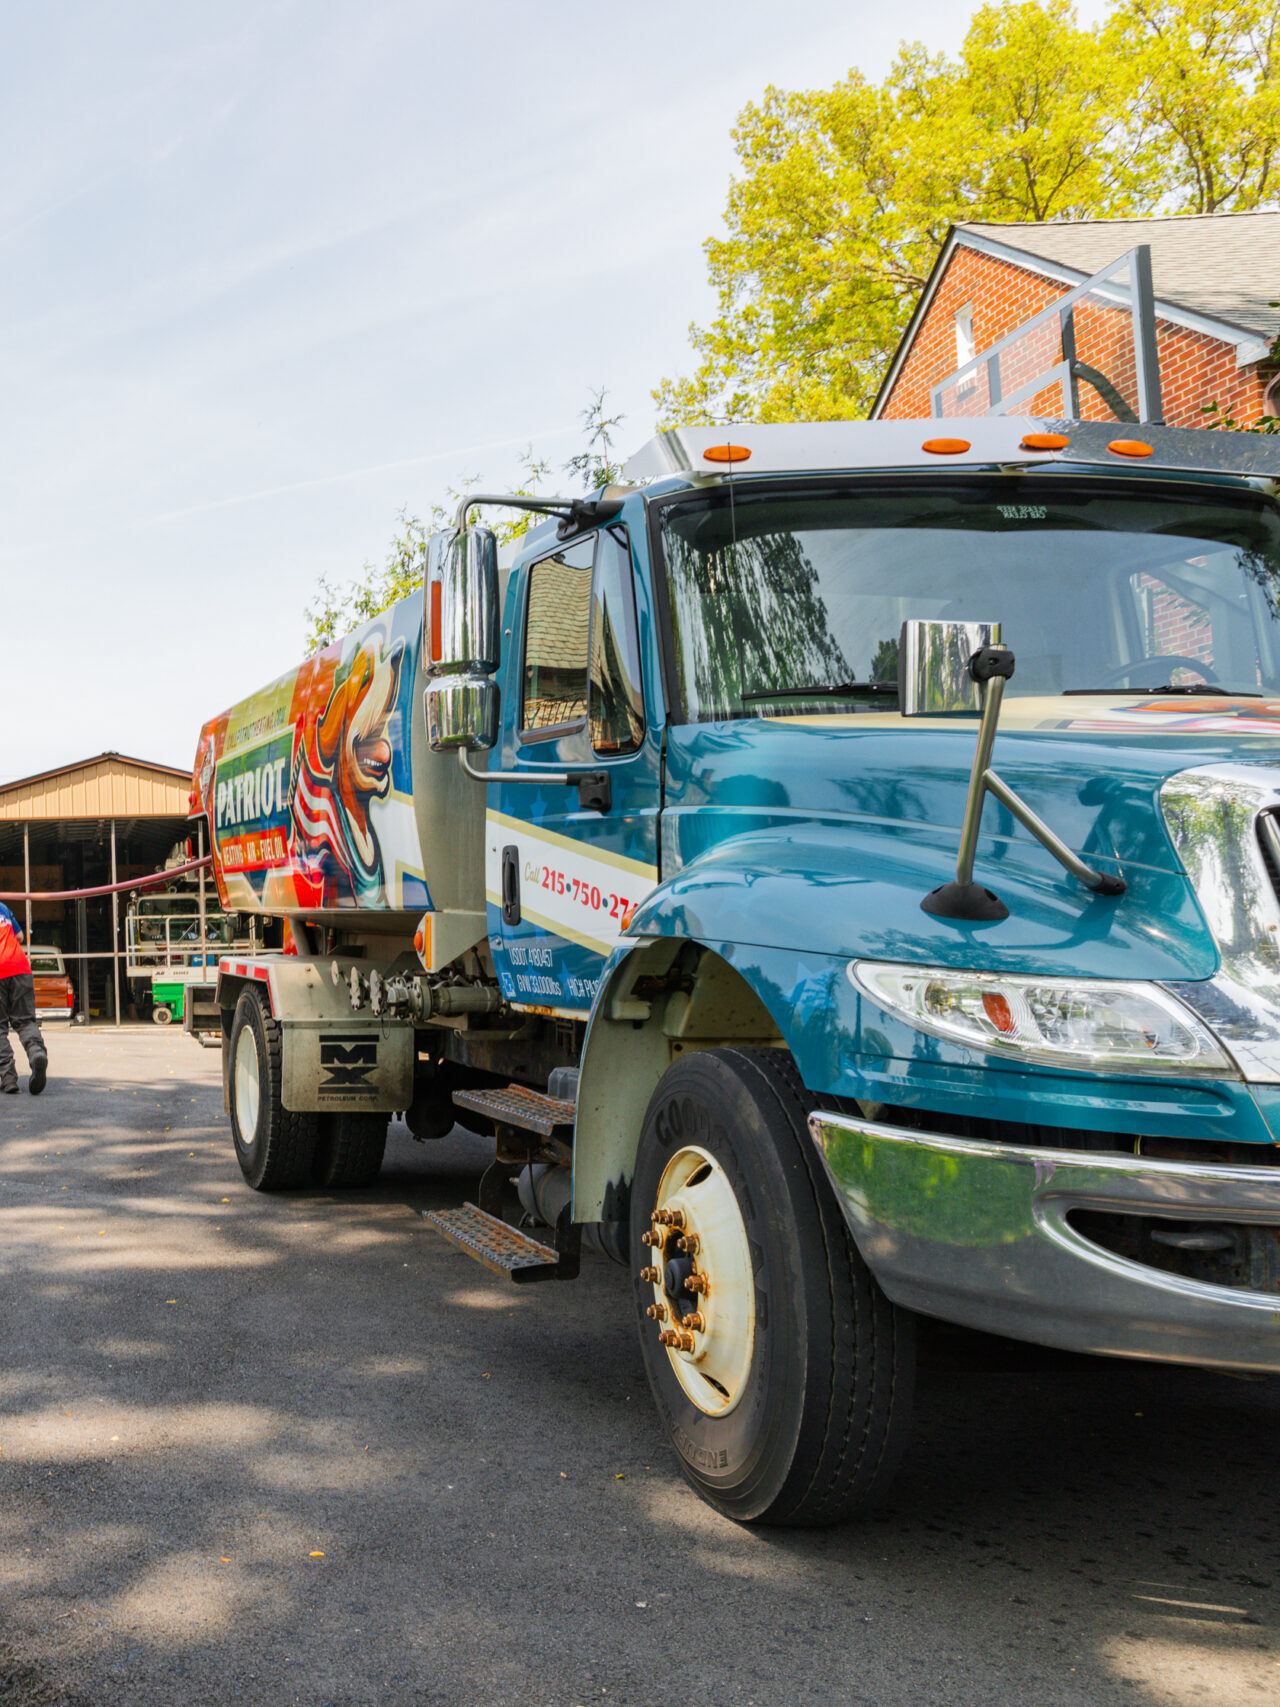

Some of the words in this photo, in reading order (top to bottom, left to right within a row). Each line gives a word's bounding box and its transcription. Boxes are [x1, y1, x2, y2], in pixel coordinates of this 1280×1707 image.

[216, 757, 286, 829] PATRIOT
[222, 843, 244, 867] HEATING
[246, 841, 257, 864] AIR
[259, 837, 275, 861] FUEL
[274, 834, 286, 860] OIL
[524, 861, 541, 884] Call
[509, 947, 528, 966] USDOT
[516, 974, 533, 993] GVW
